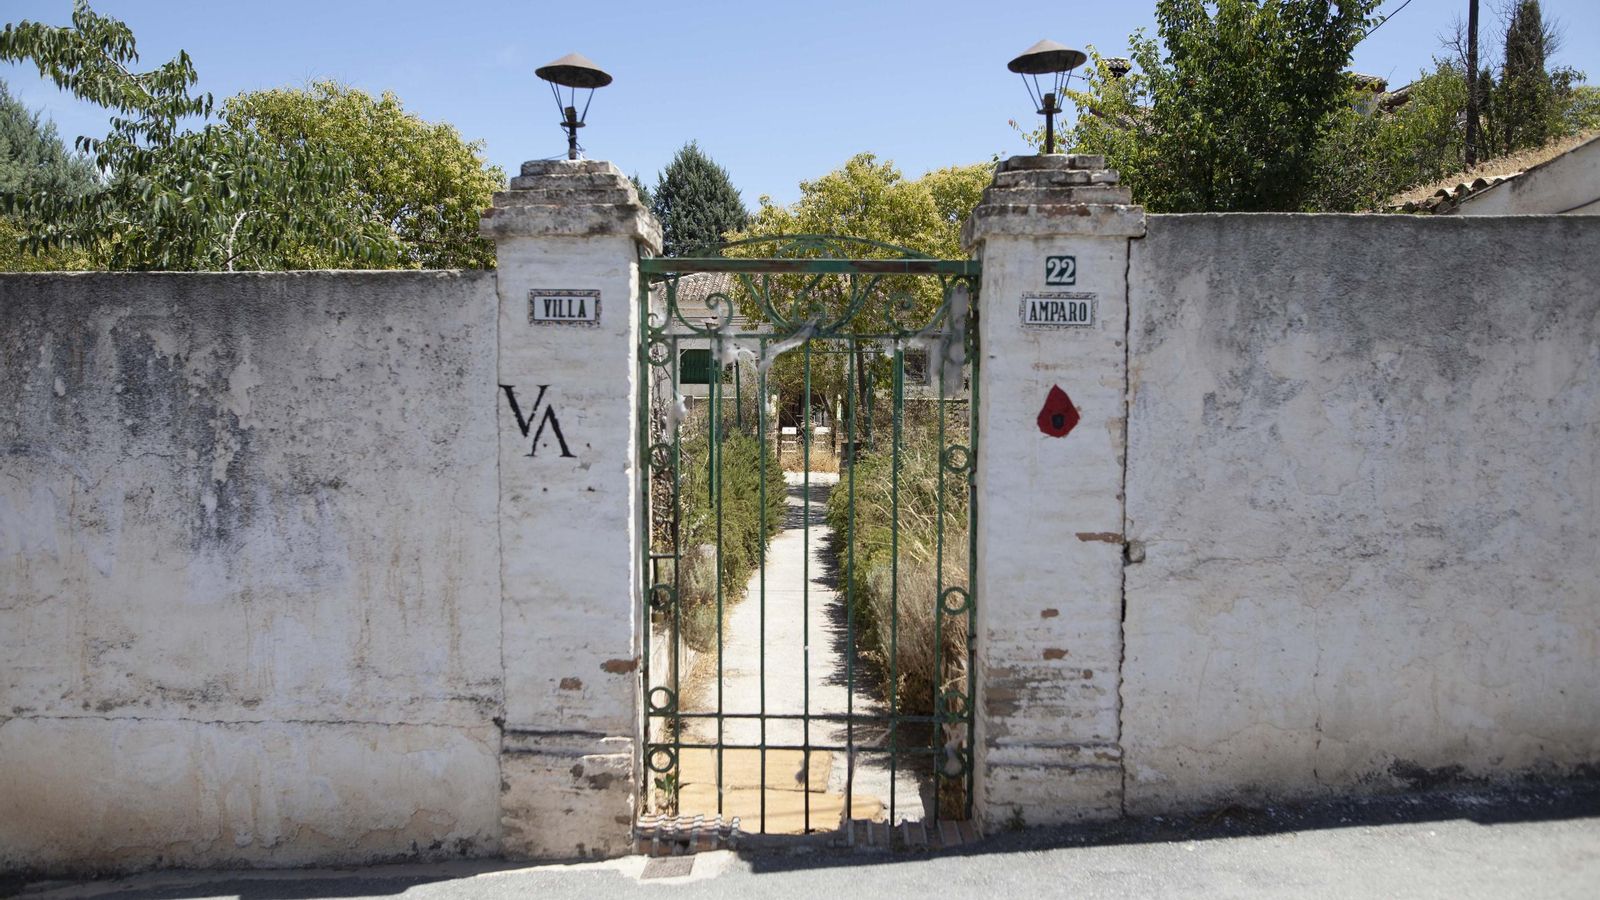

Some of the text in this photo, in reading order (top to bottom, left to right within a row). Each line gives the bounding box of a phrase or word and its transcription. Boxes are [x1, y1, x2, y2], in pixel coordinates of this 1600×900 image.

[1047, 258, 1075, 283] 22
[543, 299, 587, 318] VILLA
[1029, 301, 1087, 322] AMPARO
